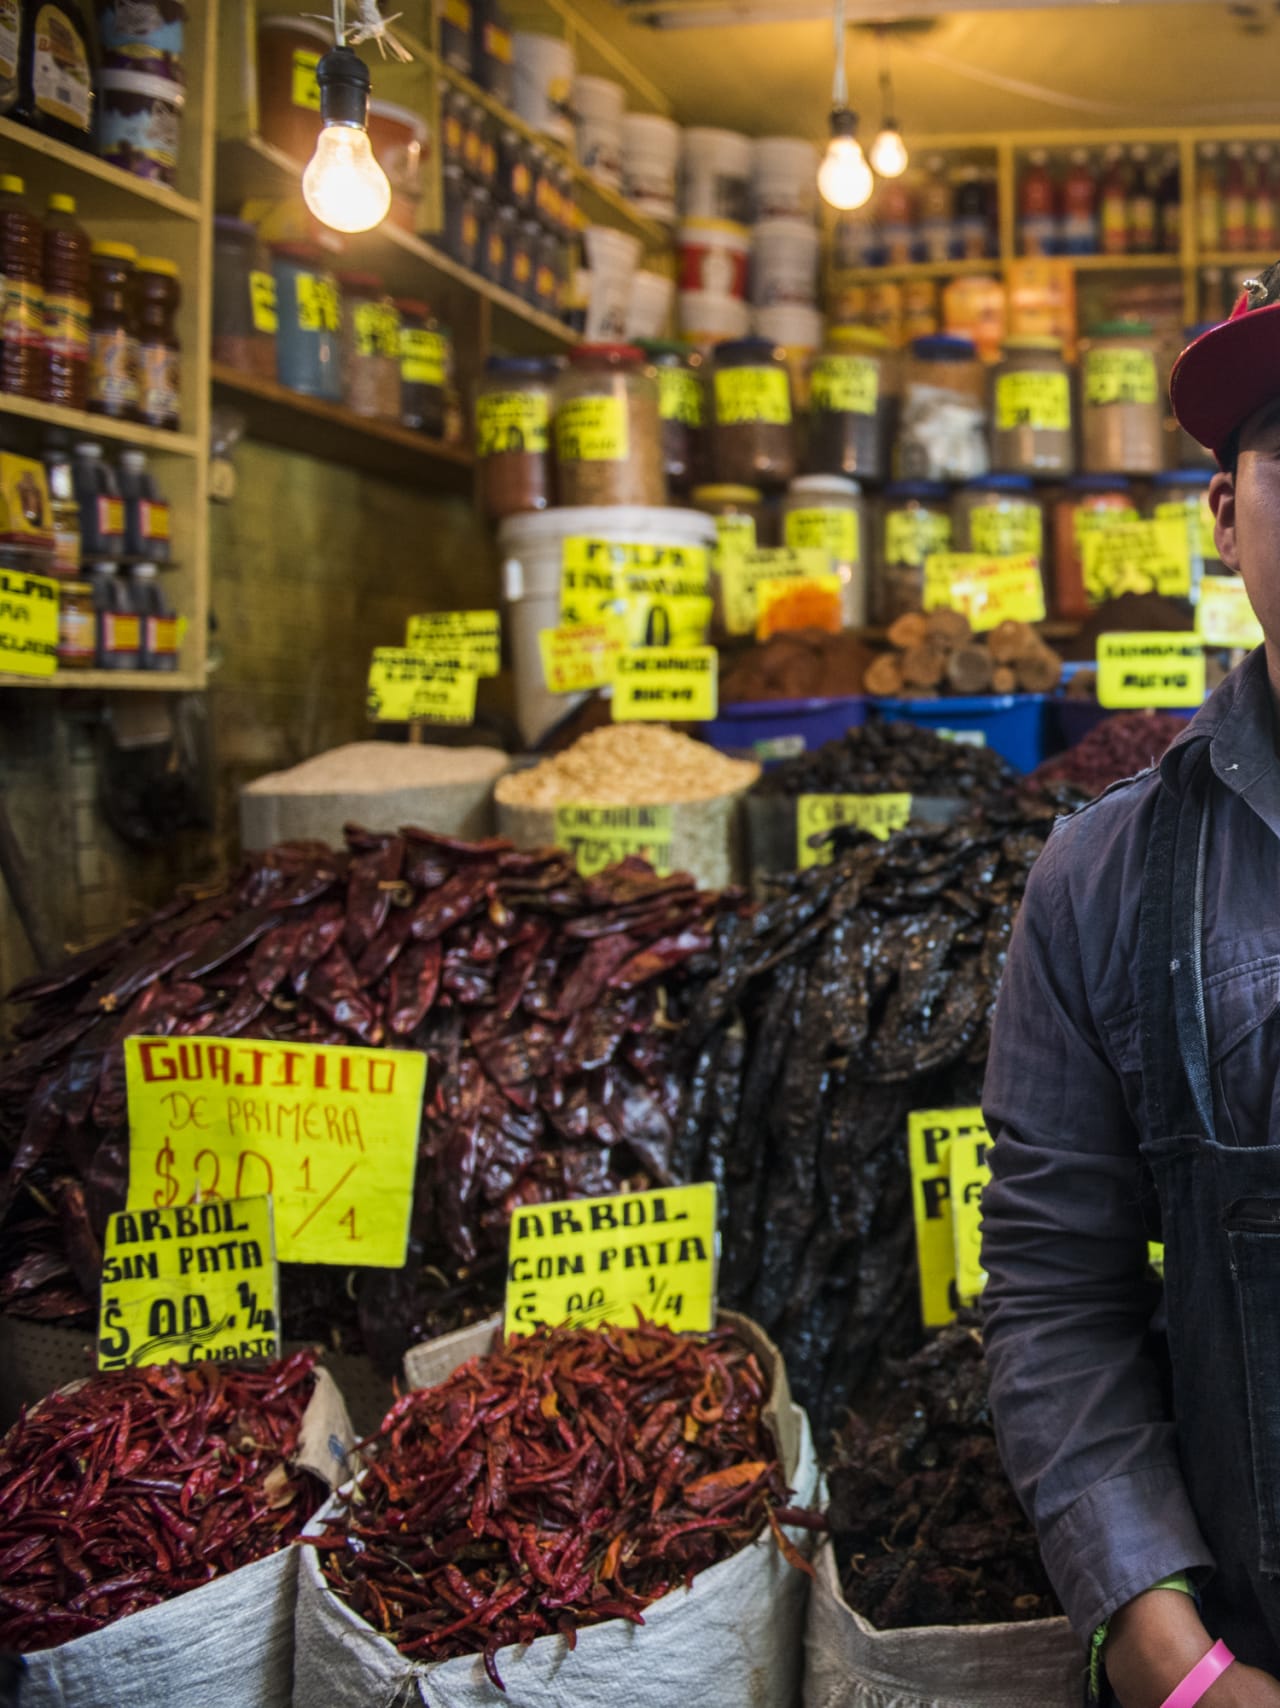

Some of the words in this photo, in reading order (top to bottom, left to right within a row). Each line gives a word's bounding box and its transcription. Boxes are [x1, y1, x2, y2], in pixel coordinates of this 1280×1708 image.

[138, 1041, 397, 1094] GUAJILLO
[159, 1090, 211, 1130] DE
[226, 1095, 366, 1153] PRIMERA
[115, 1202, 249, 1245] ARBOL
[517, 1197, 688, 1239] ARBOL
[102, 1252, 159, 1283] SIN
[178, 1240, 263, 1275] PATA
[509, 1254, 585, 1282] CON
[599, 1236, 708, 1272] PATA
